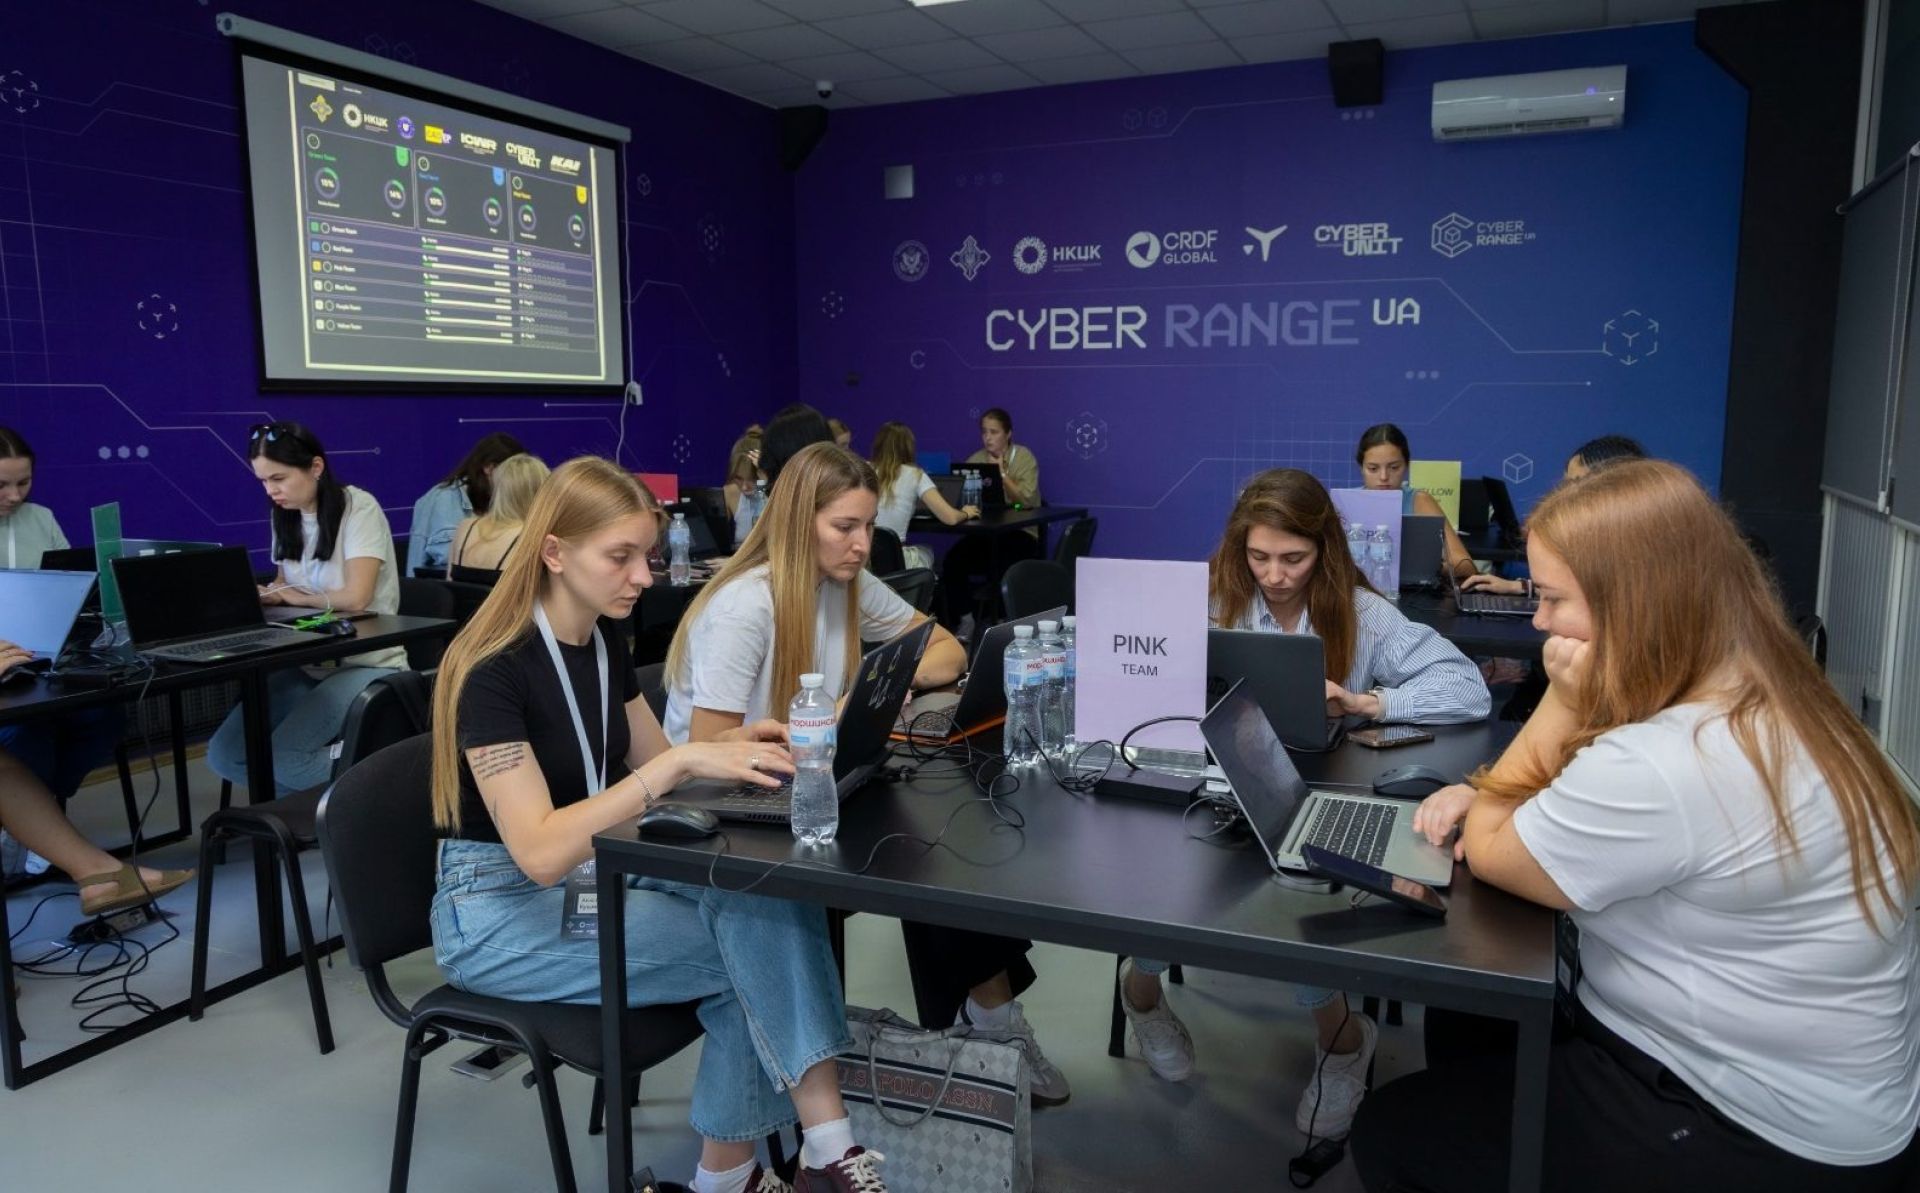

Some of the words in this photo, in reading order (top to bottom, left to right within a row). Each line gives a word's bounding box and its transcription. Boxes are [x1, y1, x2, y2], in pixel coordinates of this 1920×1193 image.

[1314, 222, 1389, 242] CYBER
[1477, 220, 1524, 234] CYBER
[1163, 230, 1218, 250] CRDF
[1343, 237, 1403, 256] UNIT
[1477, 232, 1523, 246] RANGE
[1053, 244, 1102, 263] НКЦК
[1163, 250, 1218, 265] GLOBAL
[986, 306, 1148, 351] CYBER
[1165, 300, 1361, 348] RANGE
[1373, 298, 1420, 325] UA
[1113, 634, 1168, 656] PINK
[1121, 663, 1158, 677] TEAM
[879, 1072, 935, 1100] POLO
